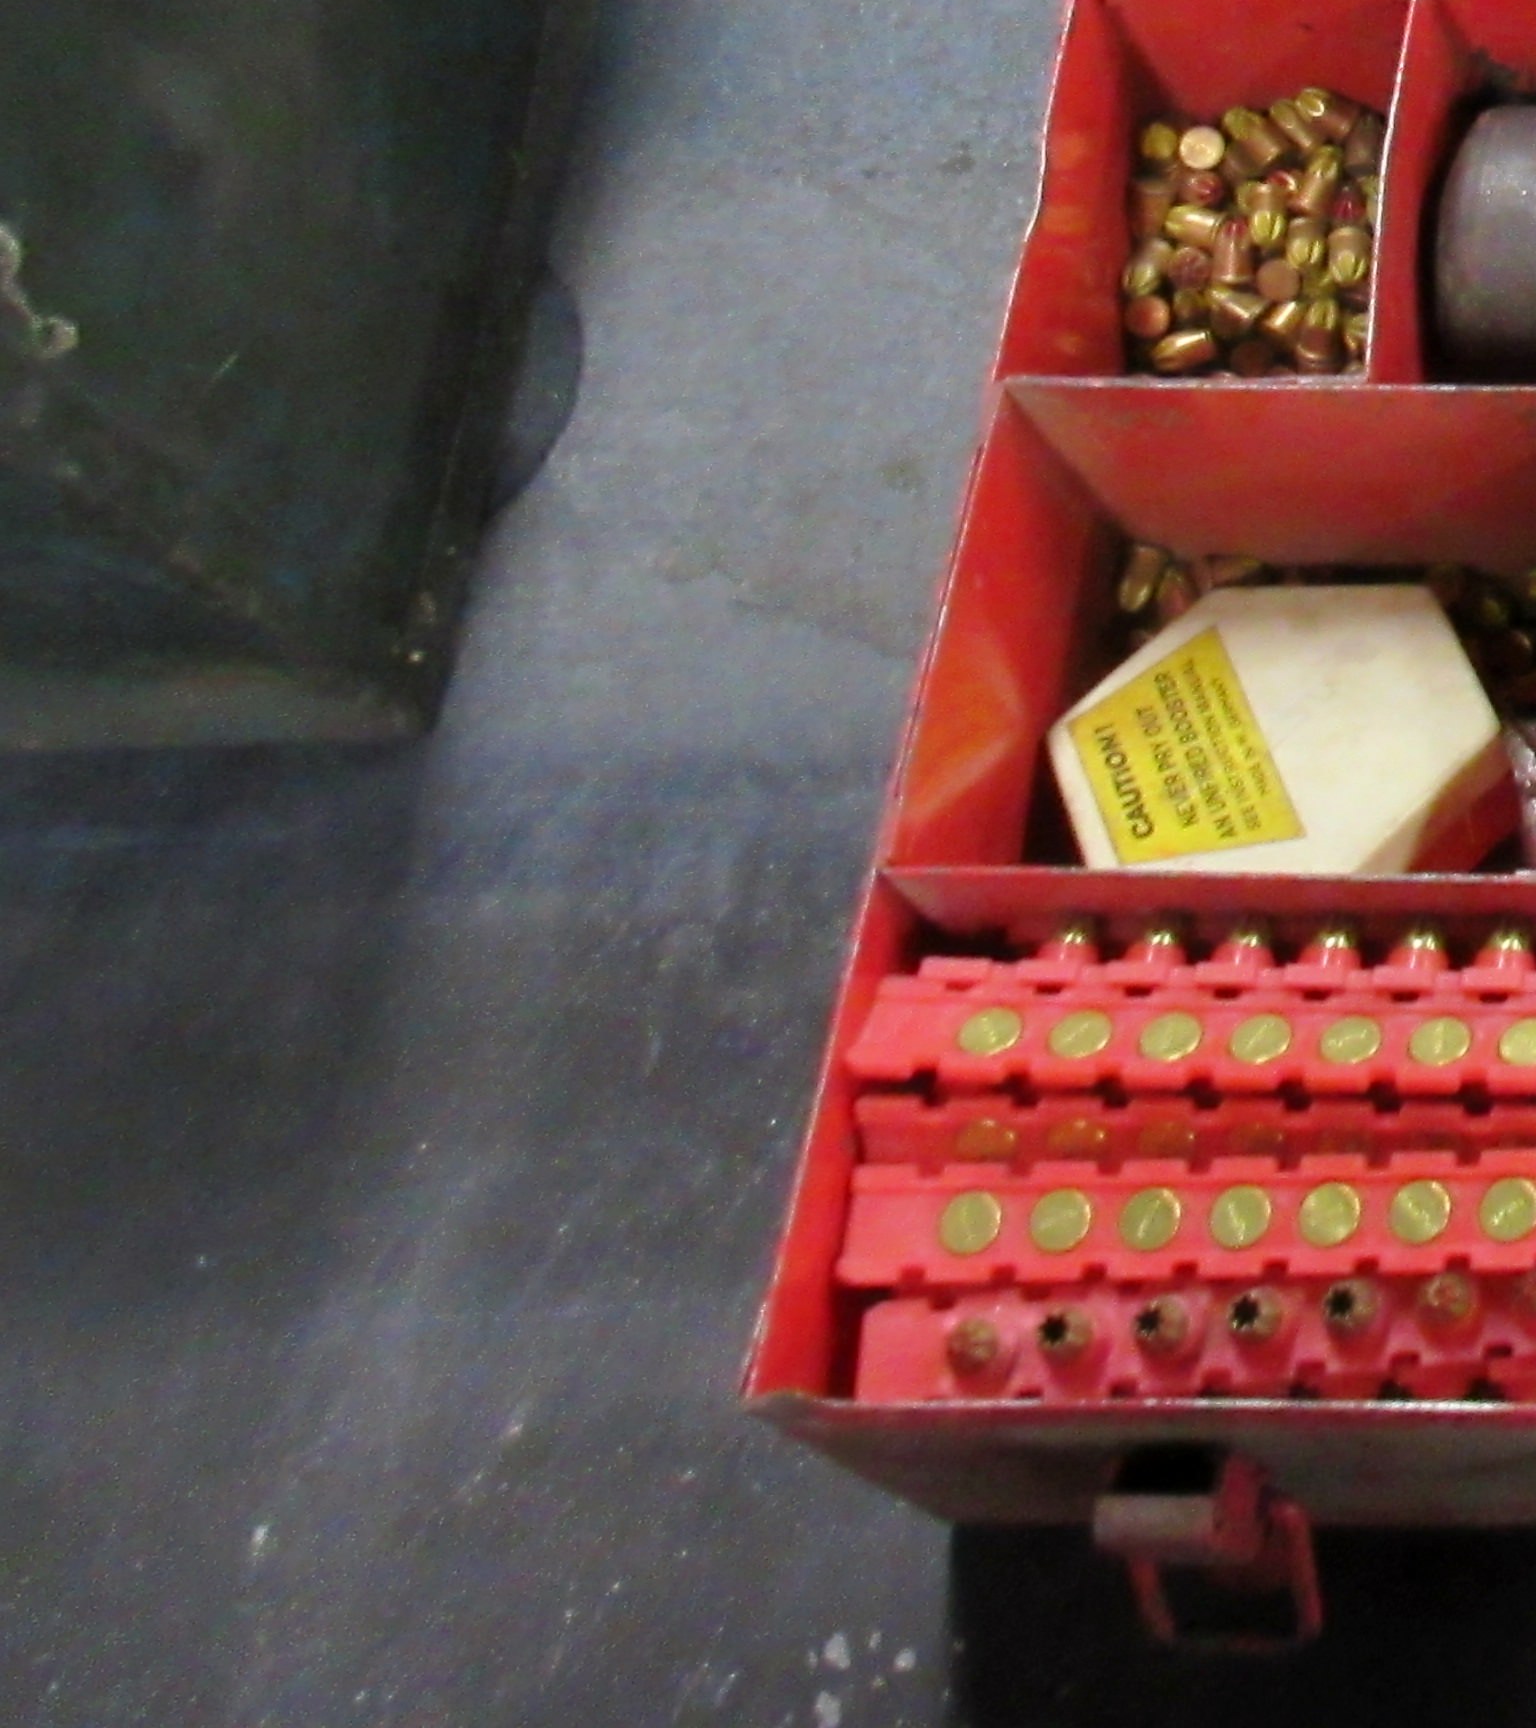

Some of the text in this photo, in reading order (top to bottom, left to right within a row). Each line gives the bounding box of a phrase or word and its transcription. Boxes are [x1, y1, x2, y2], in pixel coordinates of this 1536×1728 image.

[1091, 722, 1157, 841] CAUTION!
[1135, 703, 1200, 829] NEVER PRY OUT
[1152, 669, 1238, 841] AN UNFIRED BOOSTER
[1240, 805, 1262, 831] SEE
